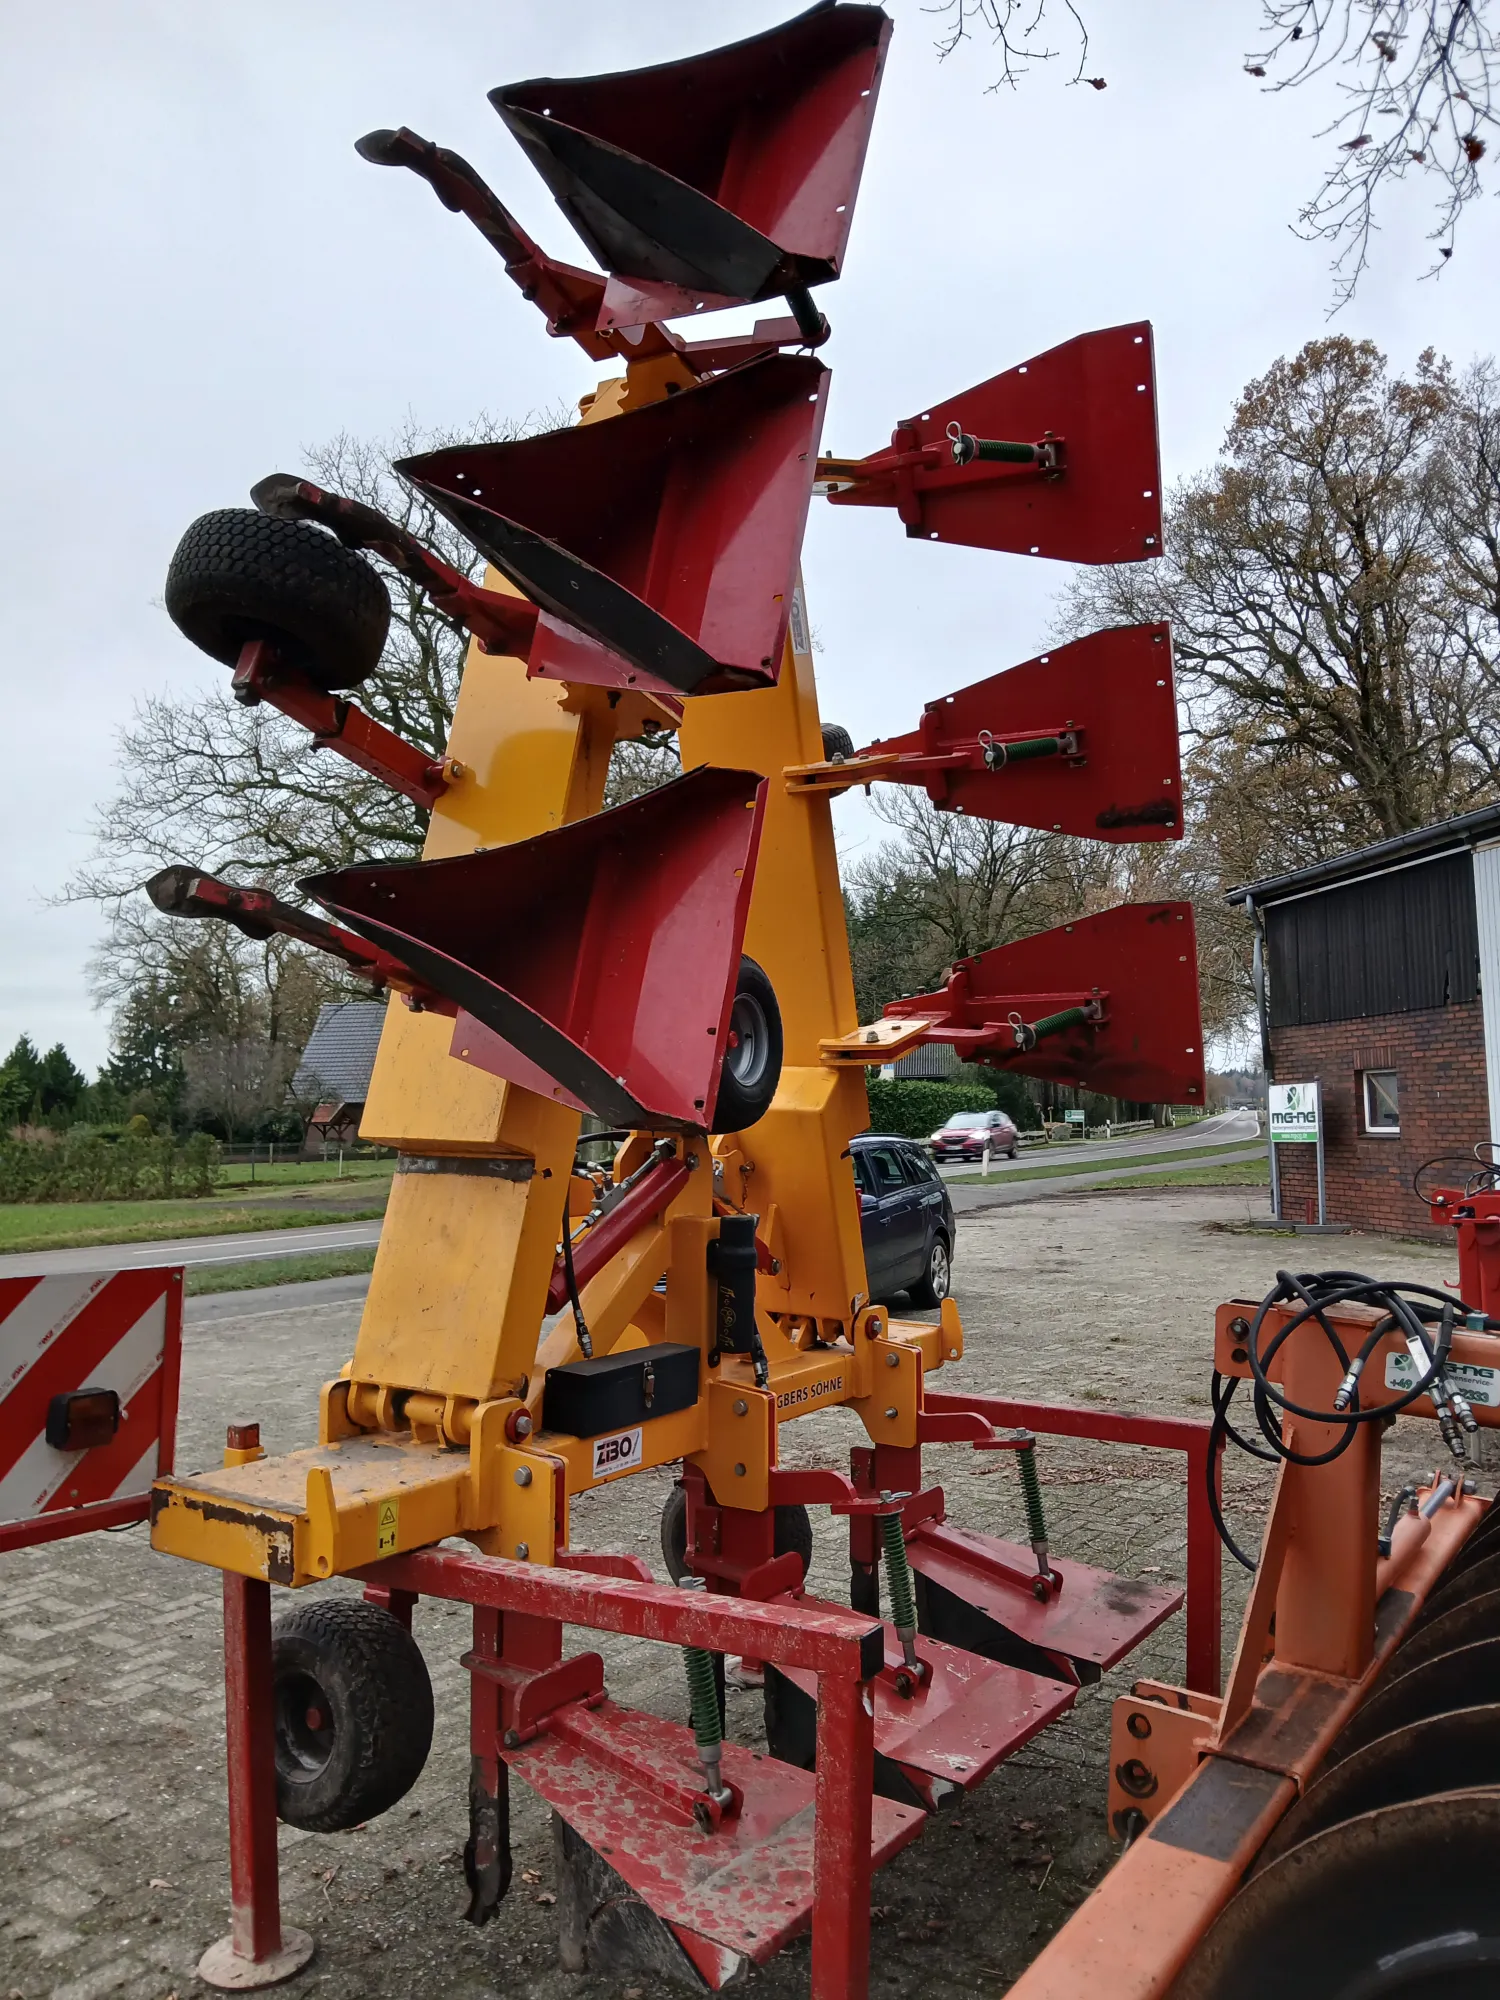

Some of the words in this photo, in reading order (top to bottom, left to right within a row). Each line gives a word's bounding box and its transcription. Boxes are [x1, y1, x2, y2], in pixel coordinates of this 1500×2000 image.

[1445, 1363, 1495, 1379] G-NG
[777, 1386, 808, 1409] GBERS
[811, 1376, 842, 1398] SÖHNE
